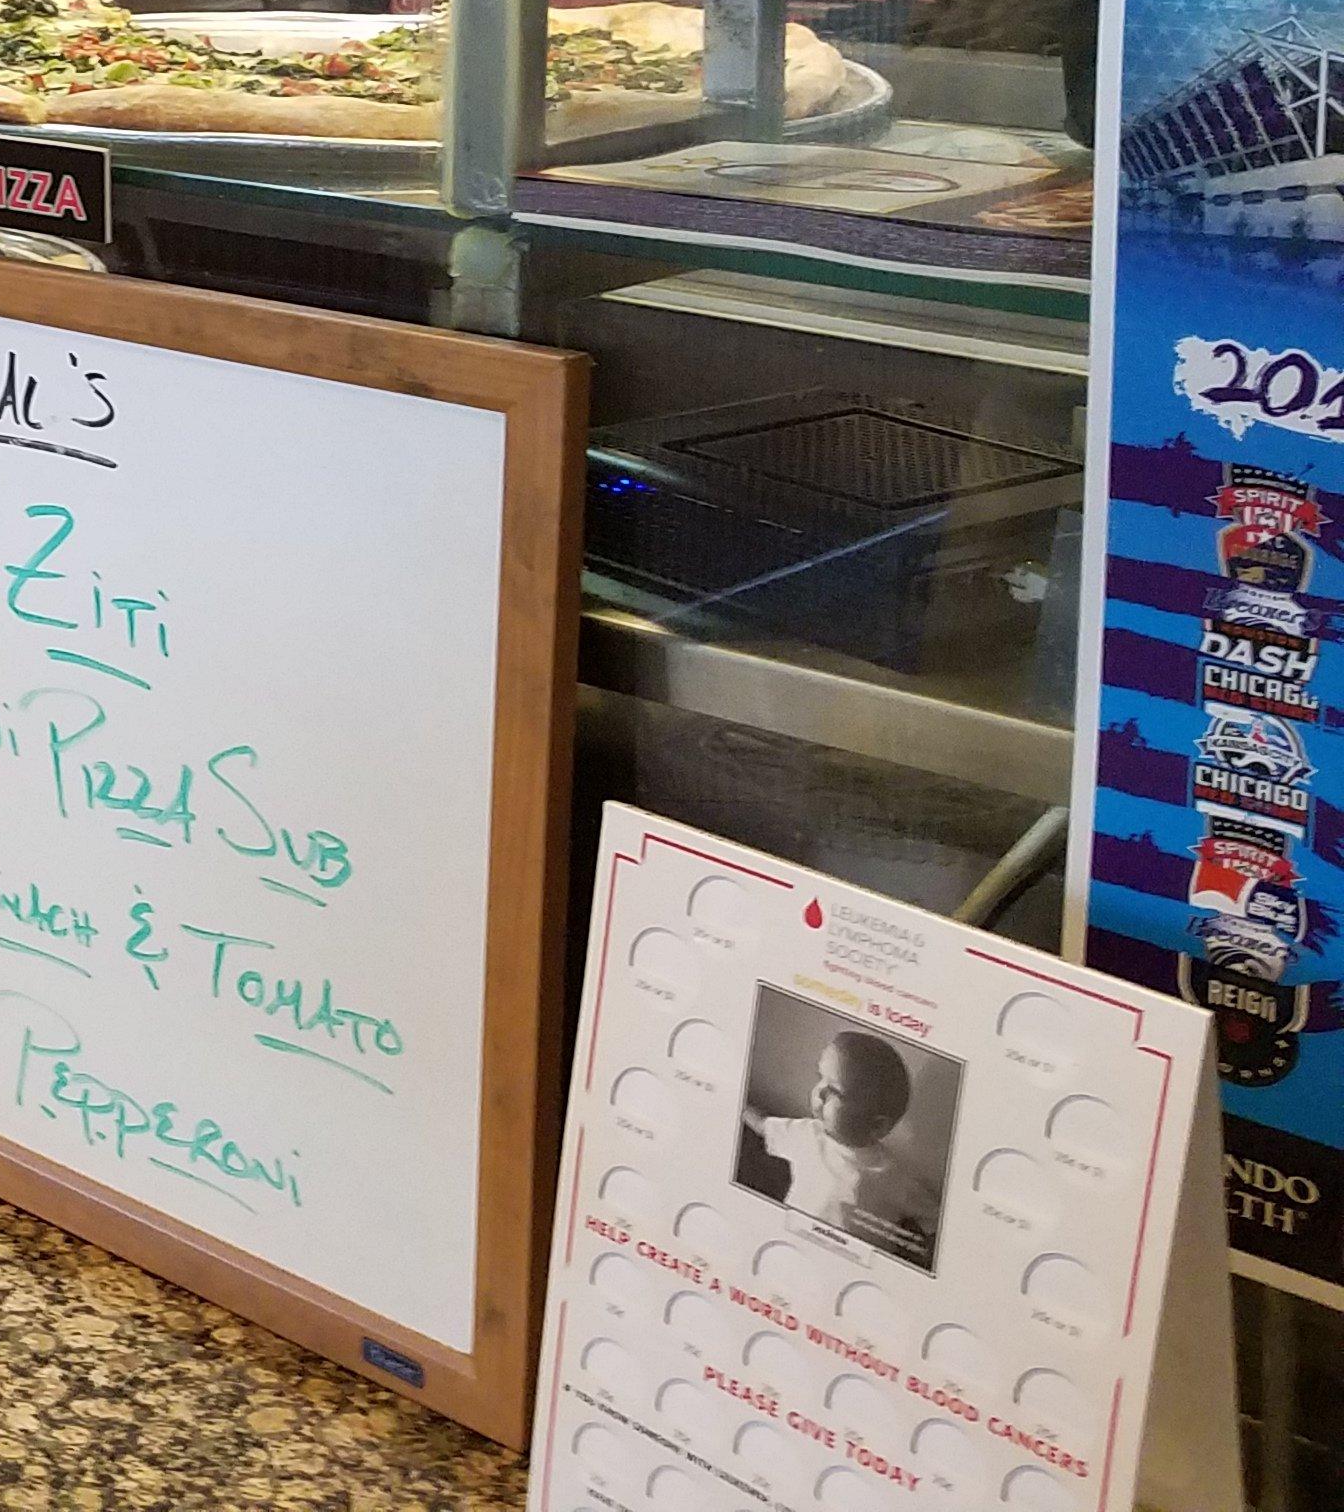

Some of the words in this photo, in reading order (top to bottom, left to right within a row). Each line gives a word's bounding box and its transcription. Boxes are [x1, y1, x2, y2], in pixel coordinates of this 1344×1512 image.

[1232, 488, 1304, 512] SPIRIT
[1199, 631, 1318, 682] DASH
[1204, 664, 1319, 710] CHICAGO
[1195, 764, 1308, 811] CHICAGO
[825, 940, 898, 976] SOCIETY
[885, 1006, 933, 1038] today
[585, 1214, 632, 1245] HELP
[636, 1240, 703, 1285] CREATE
[709, 1277, 722, 1294] A
[729, 1286, 800, 1332] WORLD
[806, 1324, 900, 1382] WITHOUT
[905, 1374, 980, 1422] BLOOD
[987, 1416, 1090, 1478] CANCERS
[703, 1364, 780, 1418] PLEASE
[786, 1410, 837, 1449] GIVE
[845, 1439, 922, 1492] TODAY
